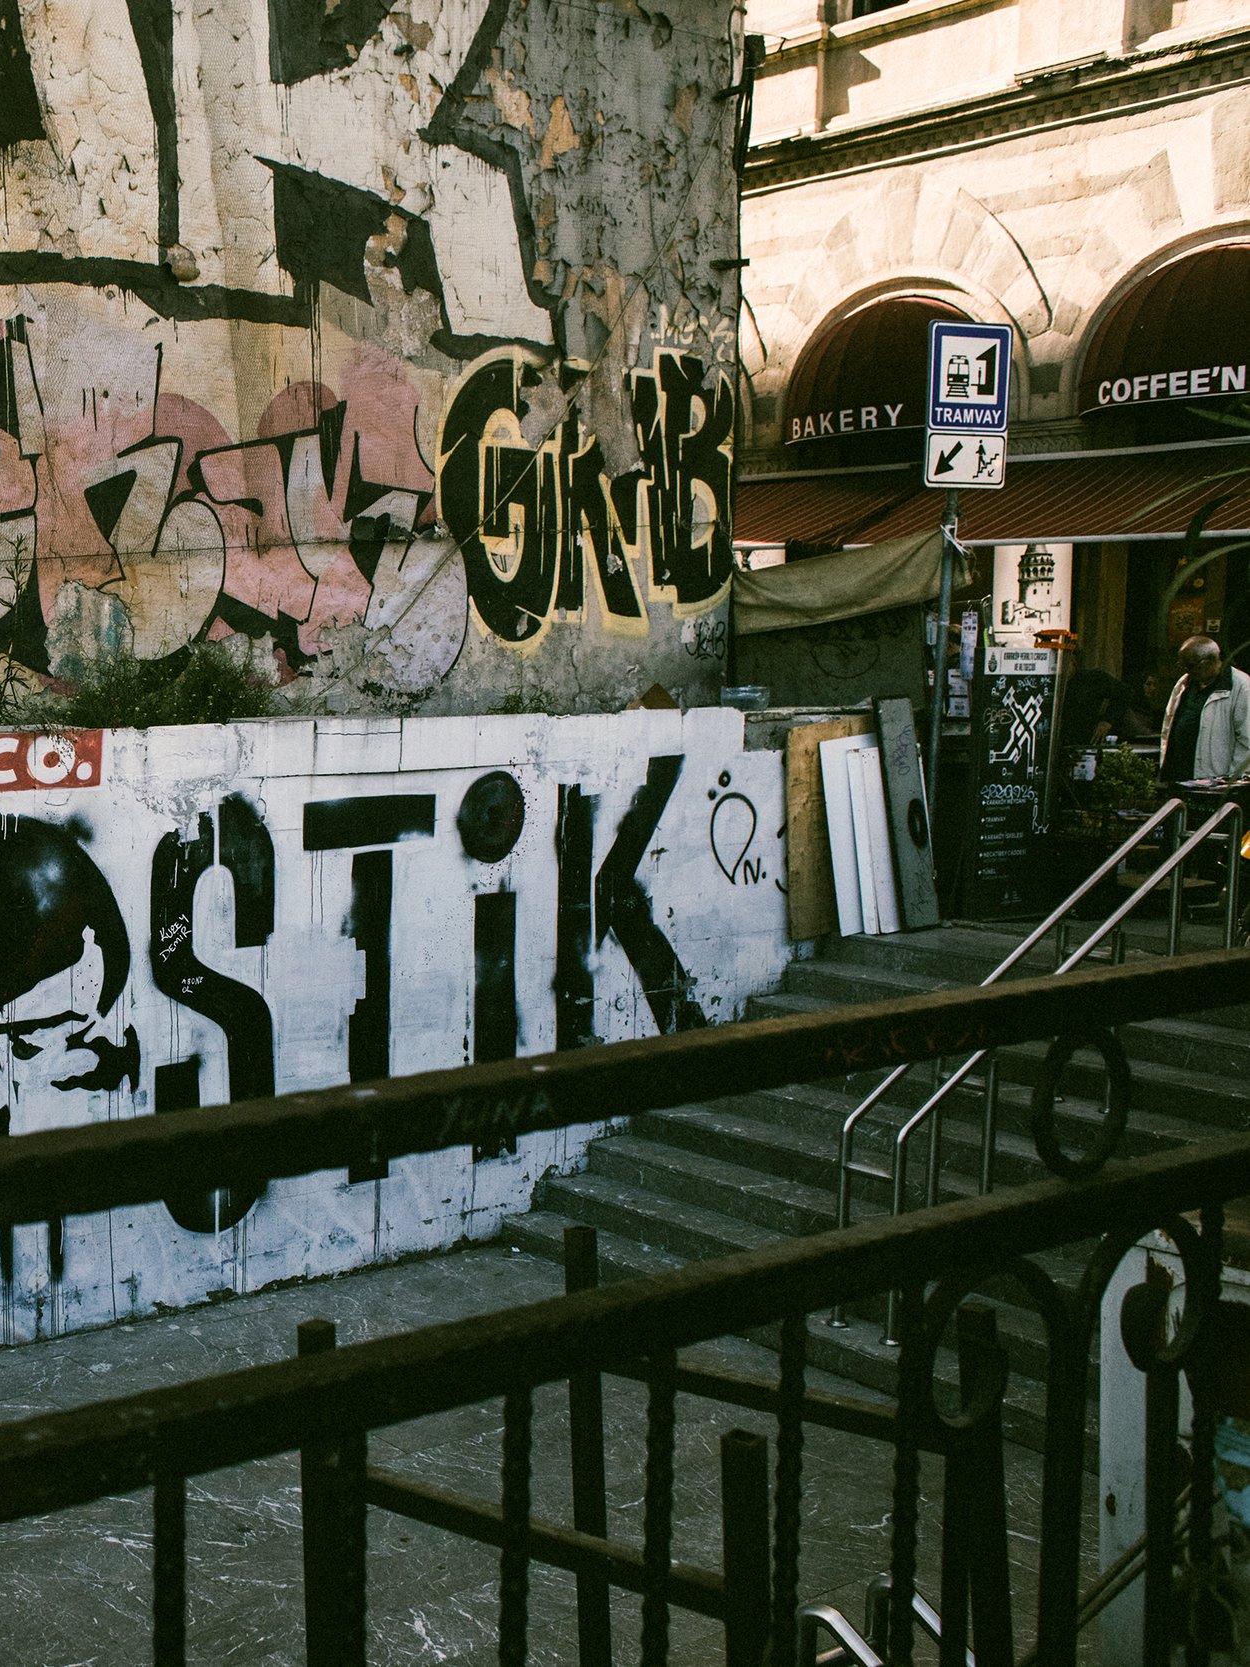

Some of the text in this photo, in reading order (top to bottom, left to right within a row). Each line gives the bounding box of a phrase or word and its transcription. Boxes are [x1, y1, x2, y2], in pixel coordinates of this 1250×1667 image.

[1098, 364, 1247, 405] COFFEE'N
[792, 403, 904, 439] BAKERY
[934, 407, 1002, 425] TRAMVAY
